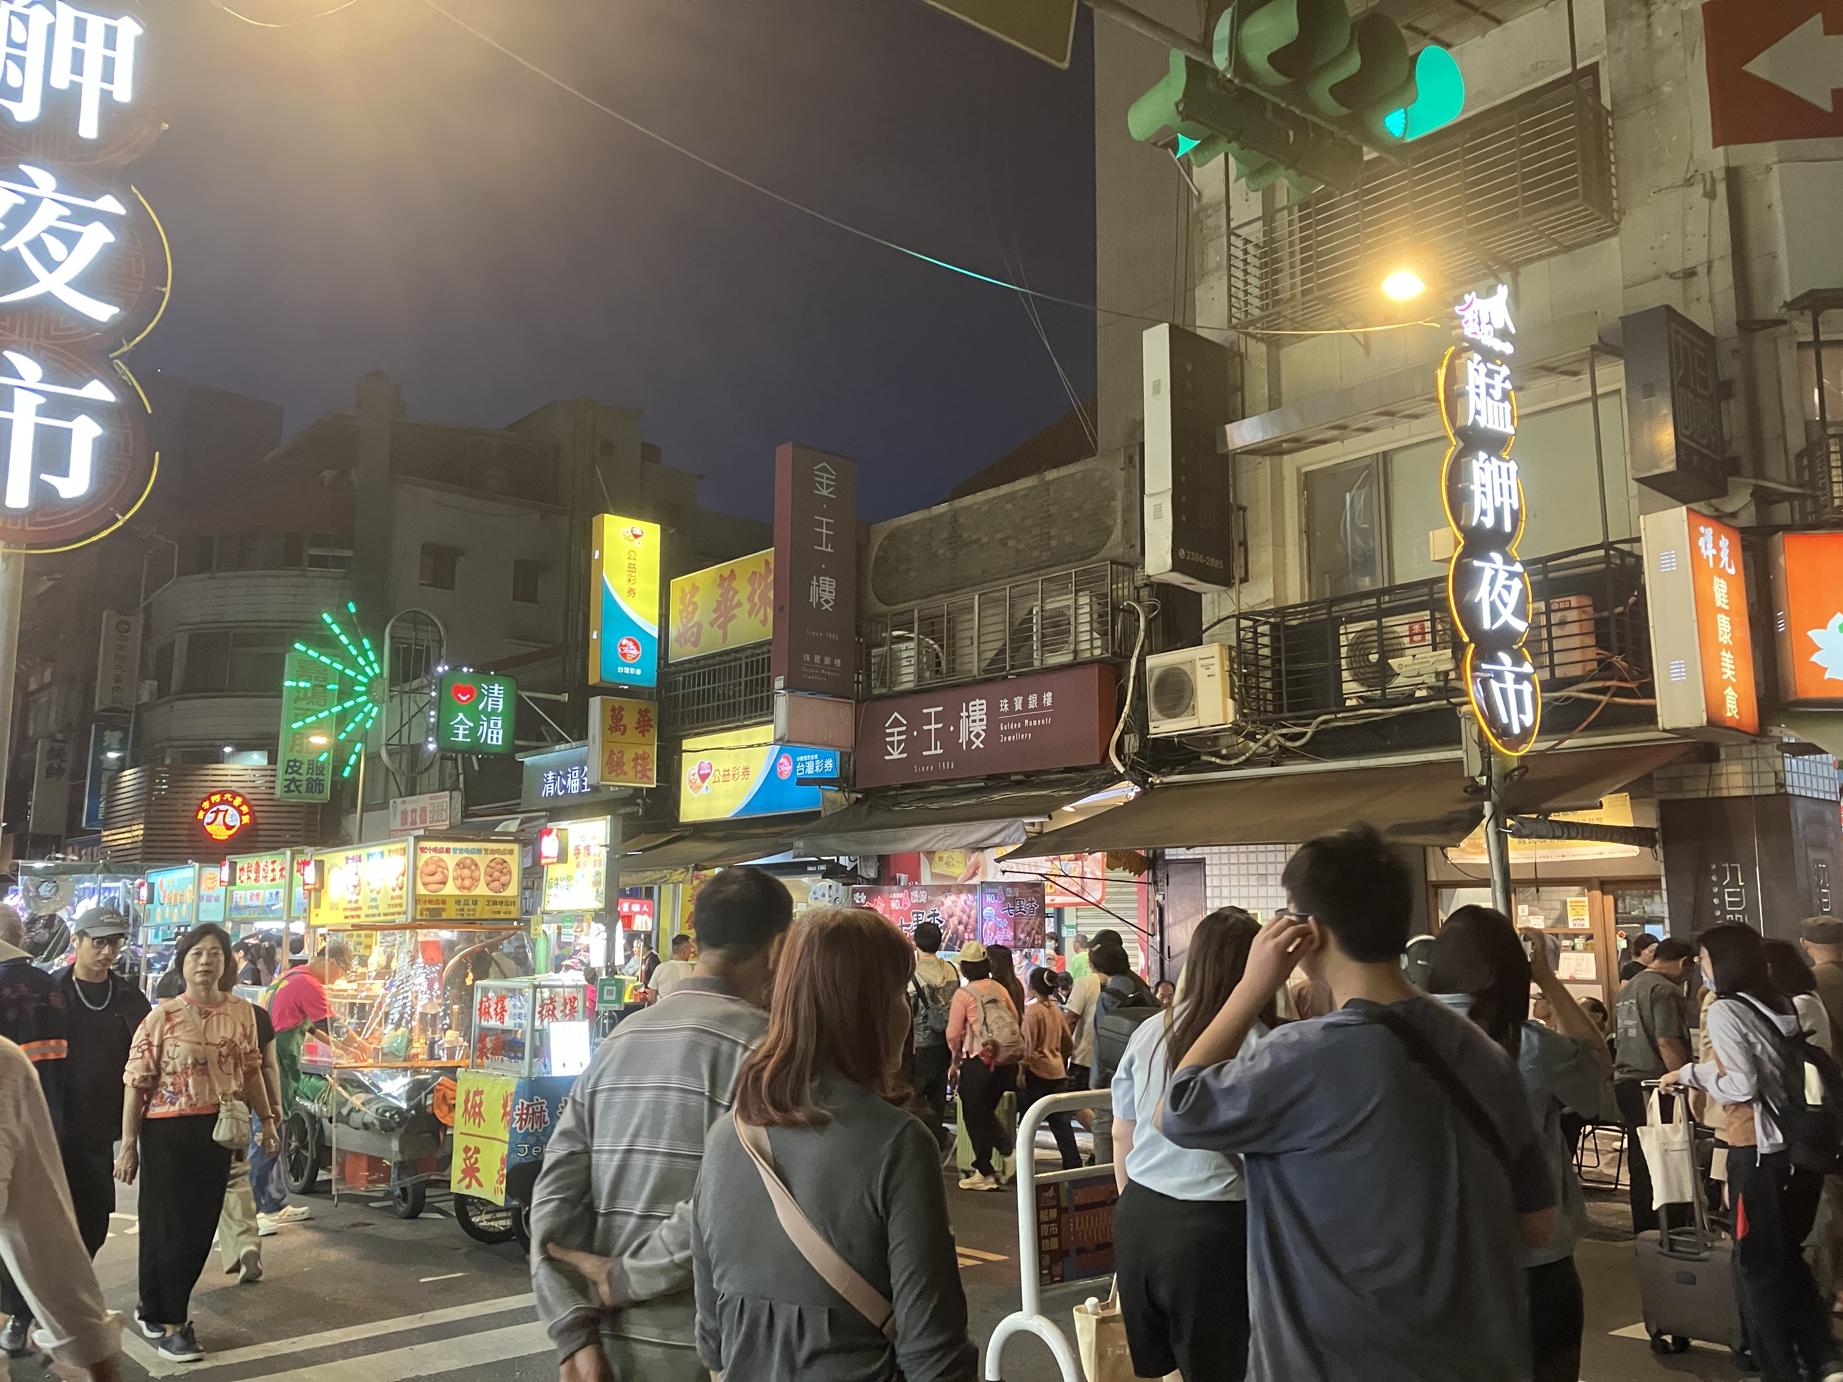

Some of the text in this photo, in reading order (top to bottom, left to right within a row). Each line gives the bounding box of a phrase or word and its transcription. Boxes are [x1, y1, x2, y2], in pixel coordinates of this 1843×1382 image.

[1465, 357, 1536, 736] 艋舺夜市
[999, 691, 1053, 713] 珠寶銀樓
[712, 766, 750, 785] 公益彩券
[796, 757, 834, 776] 台灣彩券
[1001, 897, 1040, 918] 七里香
